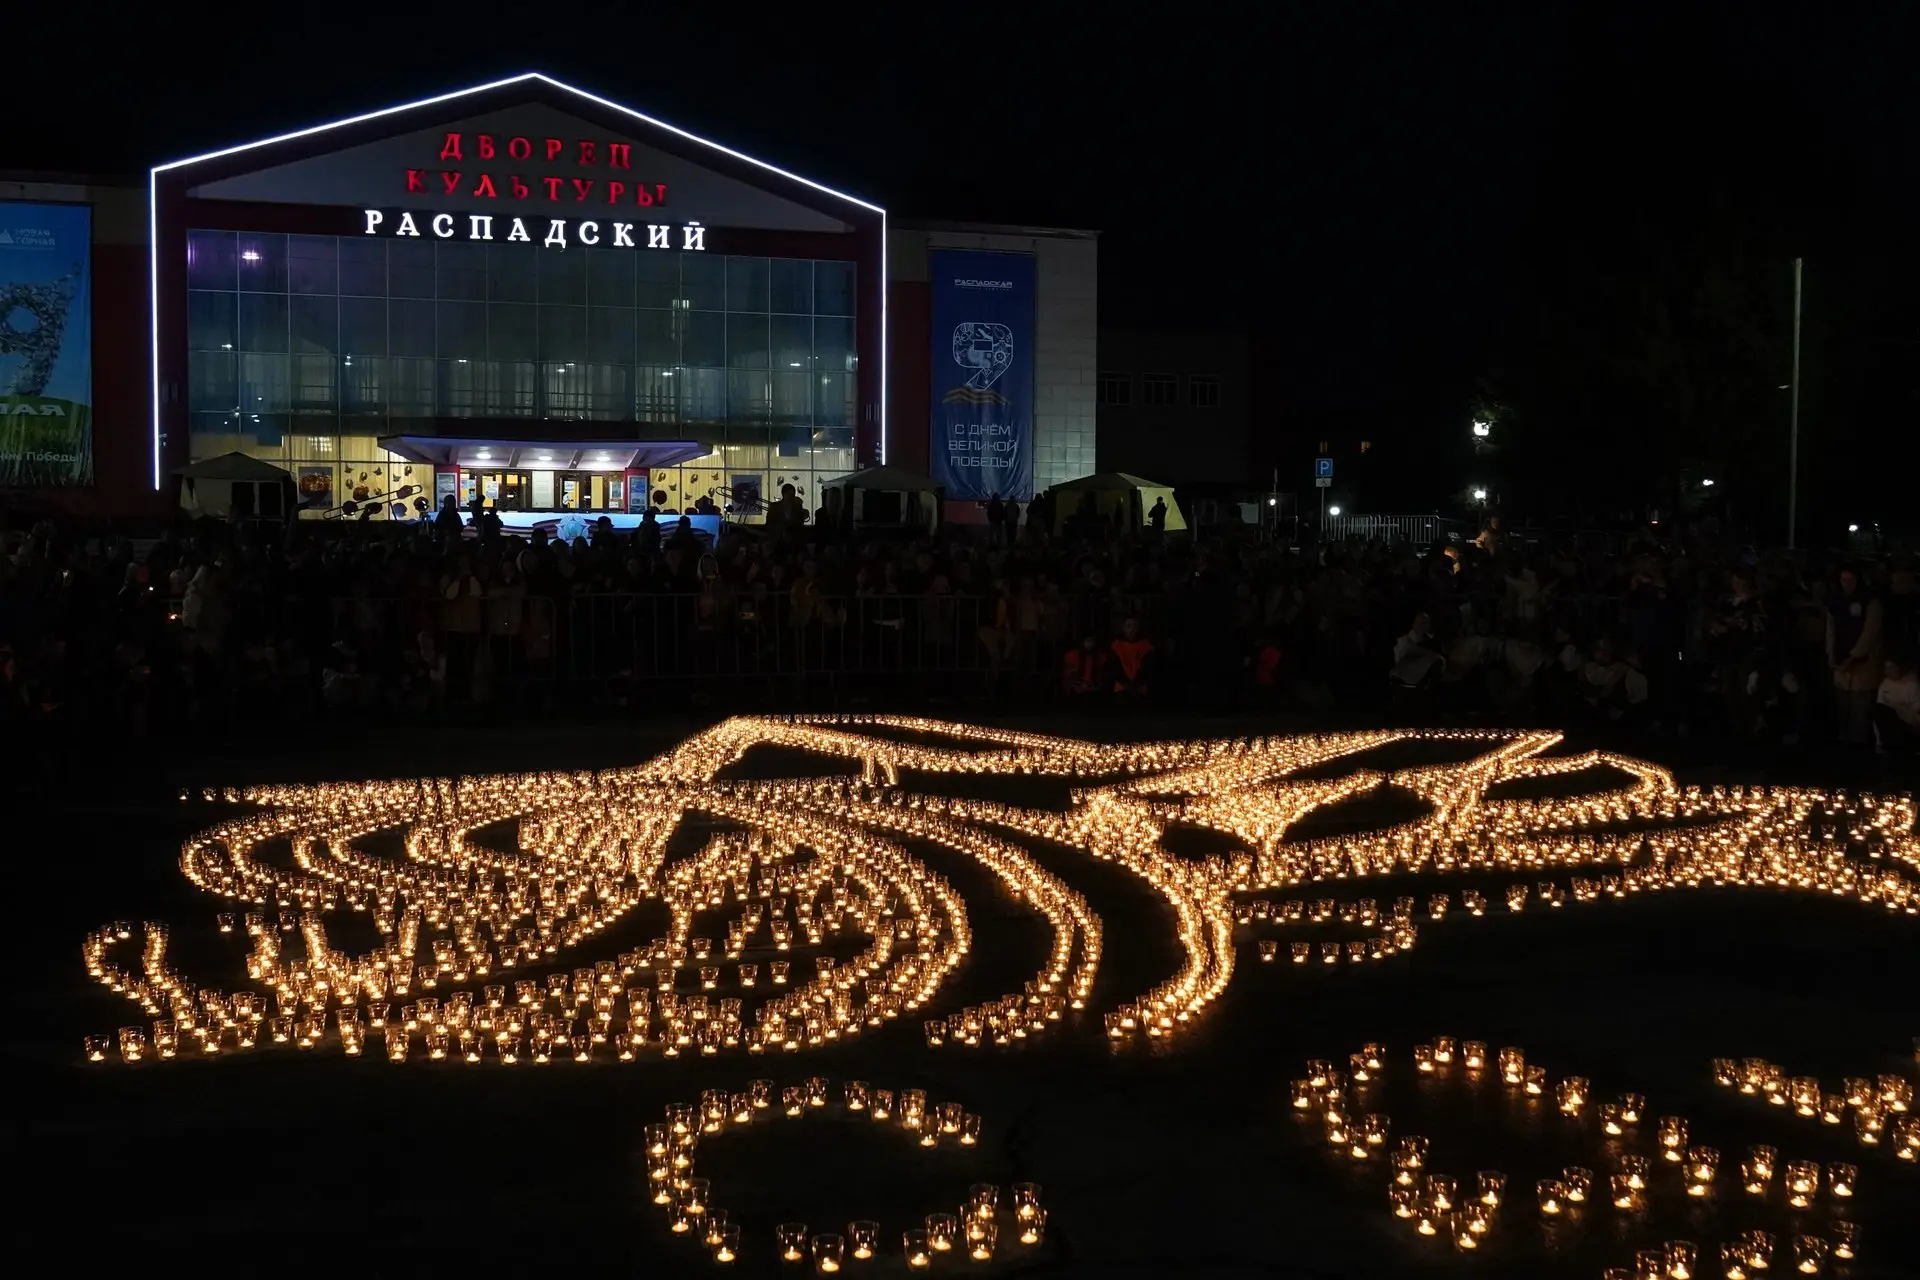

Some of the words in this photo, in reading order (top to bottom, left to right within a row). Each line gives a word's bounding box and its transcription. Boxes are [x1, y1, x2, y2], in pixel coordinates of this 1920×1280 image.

[440, 132, 632, 171] ДВОРЕЦ
[405, 169, 667, 207] КУЛЬТУРЫ
[364, 209, 706, 251] РАСПАДСКИЙ
[955, 424, 965, 435] С
[968, 423, 1011, 436] ДНЁМ
[948, 439, 1017, 452] ВЕЛИКОЙ
[1320, 461, 1330, 475] P
